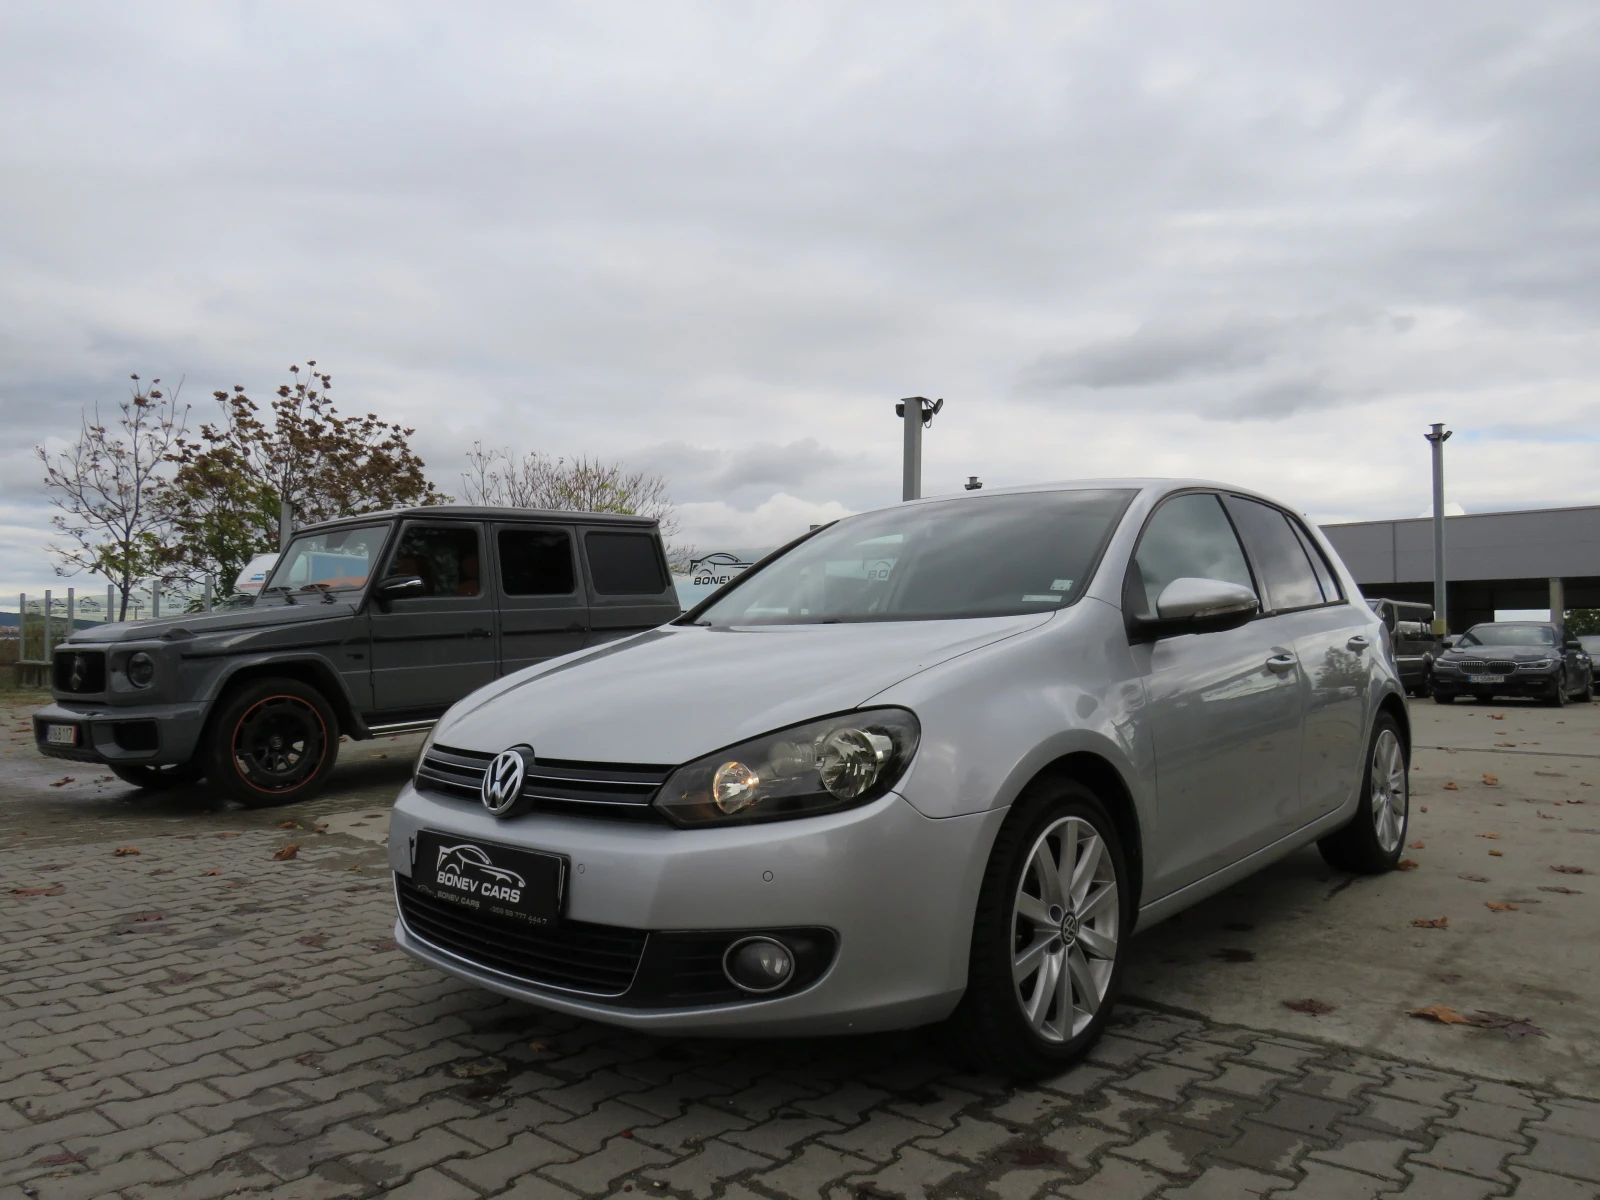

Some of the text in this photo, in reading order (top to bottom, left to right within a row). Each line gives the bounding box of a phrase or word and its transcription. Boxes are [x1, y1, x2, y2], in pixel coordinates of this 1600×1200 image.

[436, 871, 521, 904] BONEV CARS
[437, 890, 480, 908] BONEV CARS
